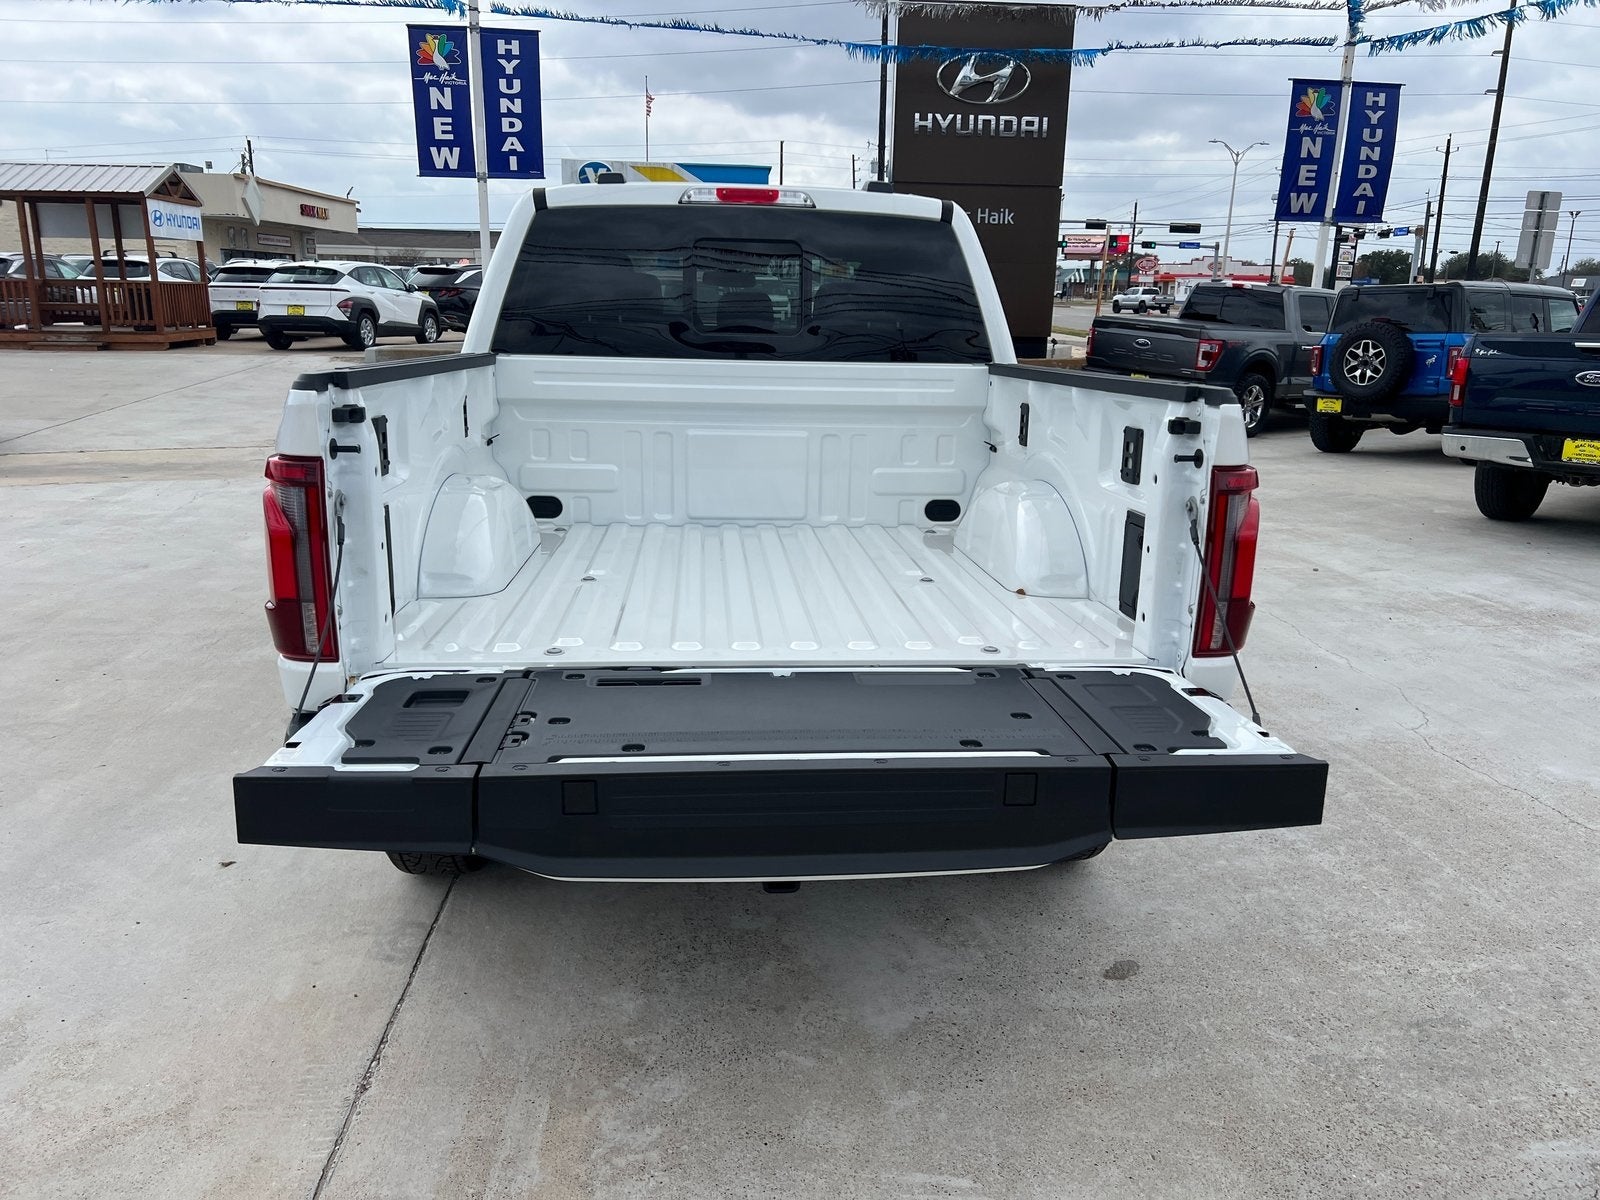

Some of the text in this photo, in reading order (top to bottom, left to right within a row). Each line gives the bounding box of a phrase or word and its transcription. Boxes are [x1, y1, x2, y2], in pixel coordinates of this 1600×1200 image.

[429, 86, 460, 170] NEW
[497, 39, 525, 171] HYUNDAI
[914, 112, 1049, 138] HYUNDAI
[1290, 137, 1322, 213] NEW
[1352, 92, 1386, 215] HYUNDAI
[165, 212, 201, 230] HYUNDAI
[977, 208, 1015, 225] Haik
